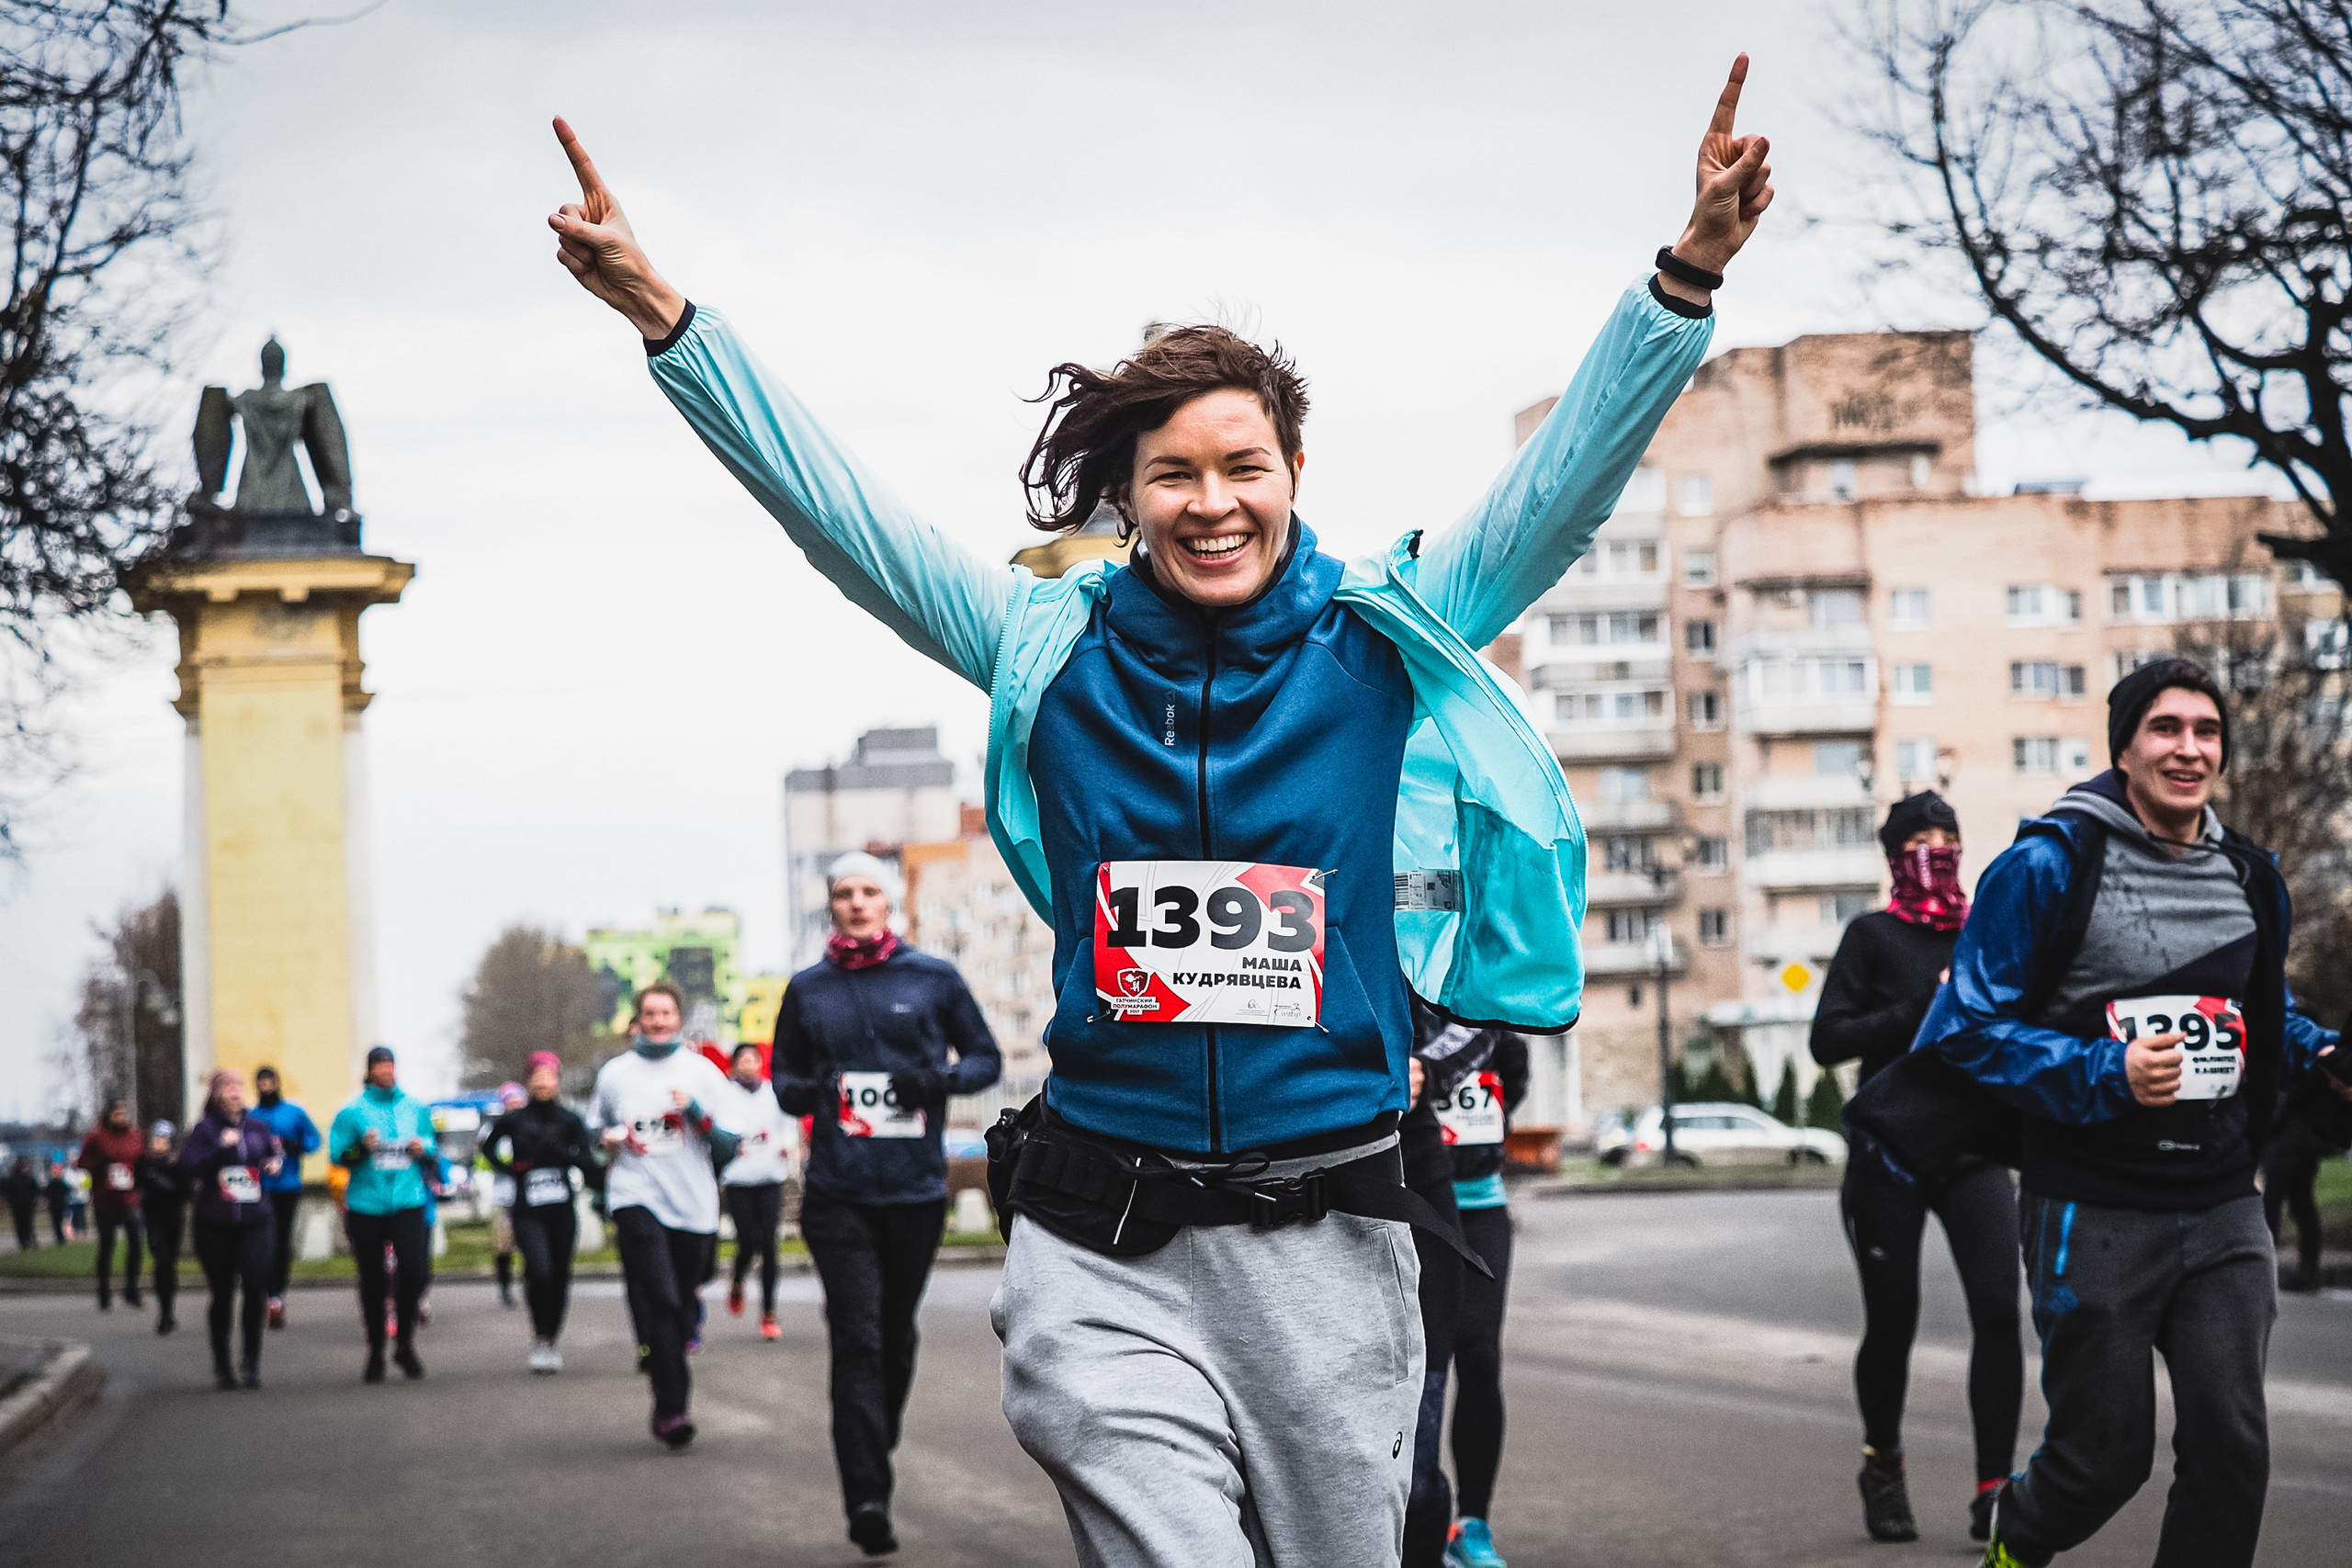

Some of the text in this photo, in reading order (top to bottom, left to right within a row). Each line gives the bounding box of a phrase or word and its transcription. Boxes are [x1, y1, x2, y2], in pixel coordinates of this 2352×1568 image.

[1164, 704, 1175, 746] Reebok
[1107, 886, 1317, 953] 1393
[1172, 972, 1302, 989] КУДРЯВЦЕВА
[1243, 956, 1303, 972] МАША
[2119, 1013, 2242, 1050] 1395
